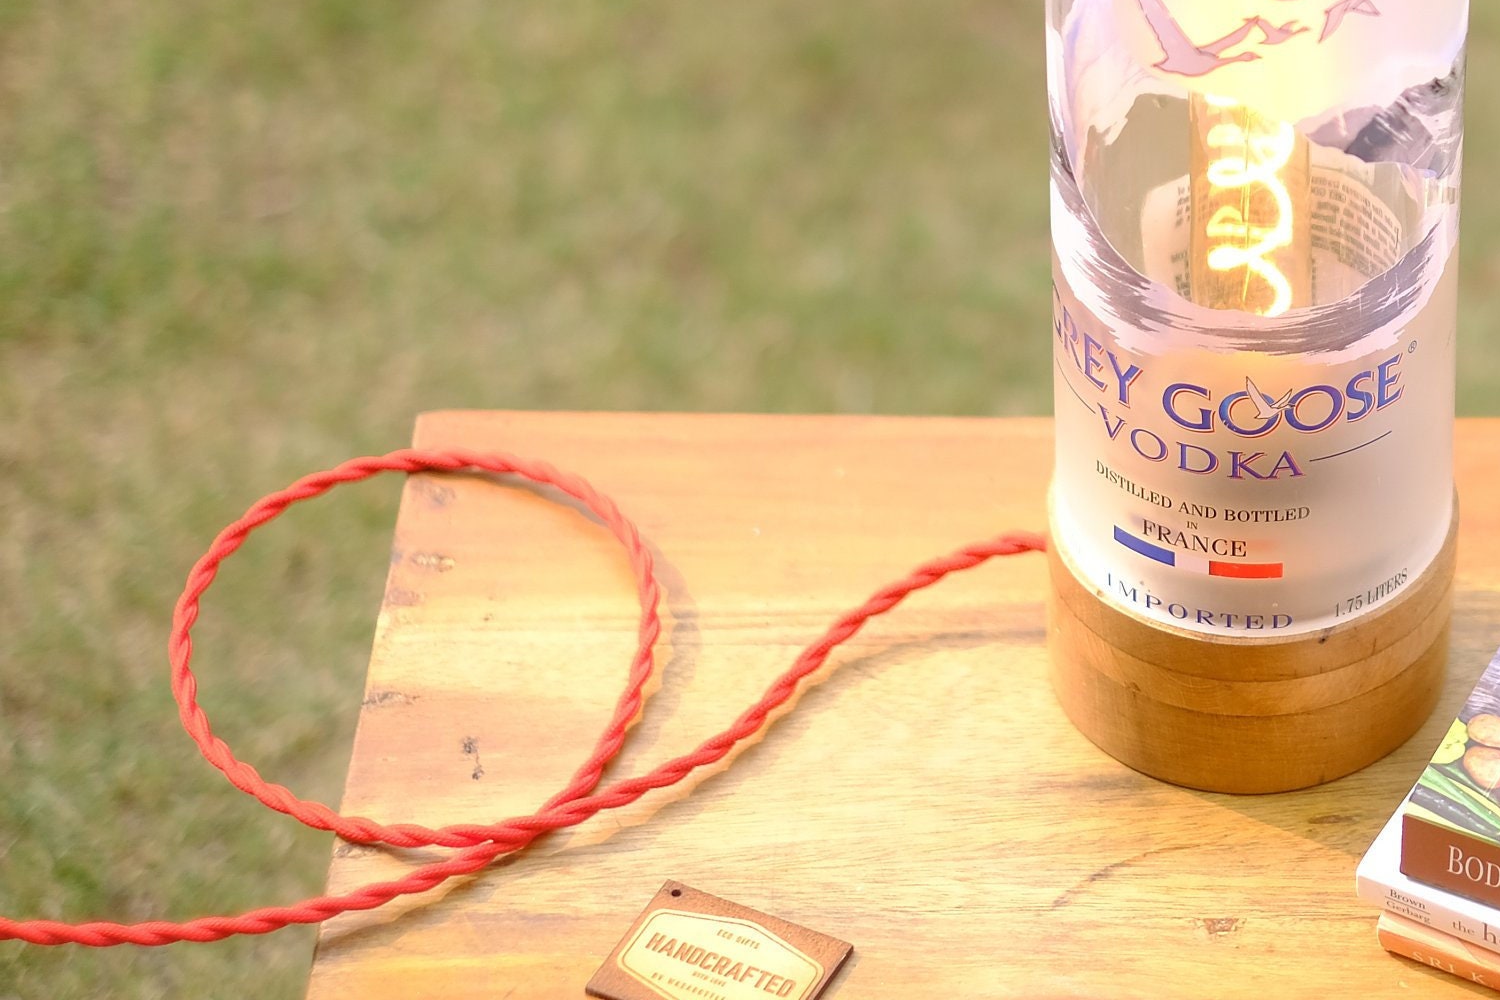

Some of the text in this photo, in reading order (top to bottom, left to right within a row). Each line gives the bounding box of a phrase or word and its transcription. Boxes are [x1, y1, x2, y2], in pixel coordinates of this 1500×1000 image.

[1162, 353, 1405, 438] GOOSE
[1097, 402, 1305, 480] VODKA
[1096, 459, 1310, 523] DISTILLED AND BOTTLED
[1142, 518, 1247, 557] FRANCE
[1186, 520, 1199, 531] IN
[1106, 572, 1293, 630] IMPORTED
[1334, 567, 1407, 617] 1.75 LITERS
[1386, 900, 1431, 925] Gerbarg
[1389, 888, 1427, 910] Brown
[1452, 919, 1476, 937] the
[645, 932, 797, 998] HANDCRAFTED
[1411, 951, 1455, 974] SRI
